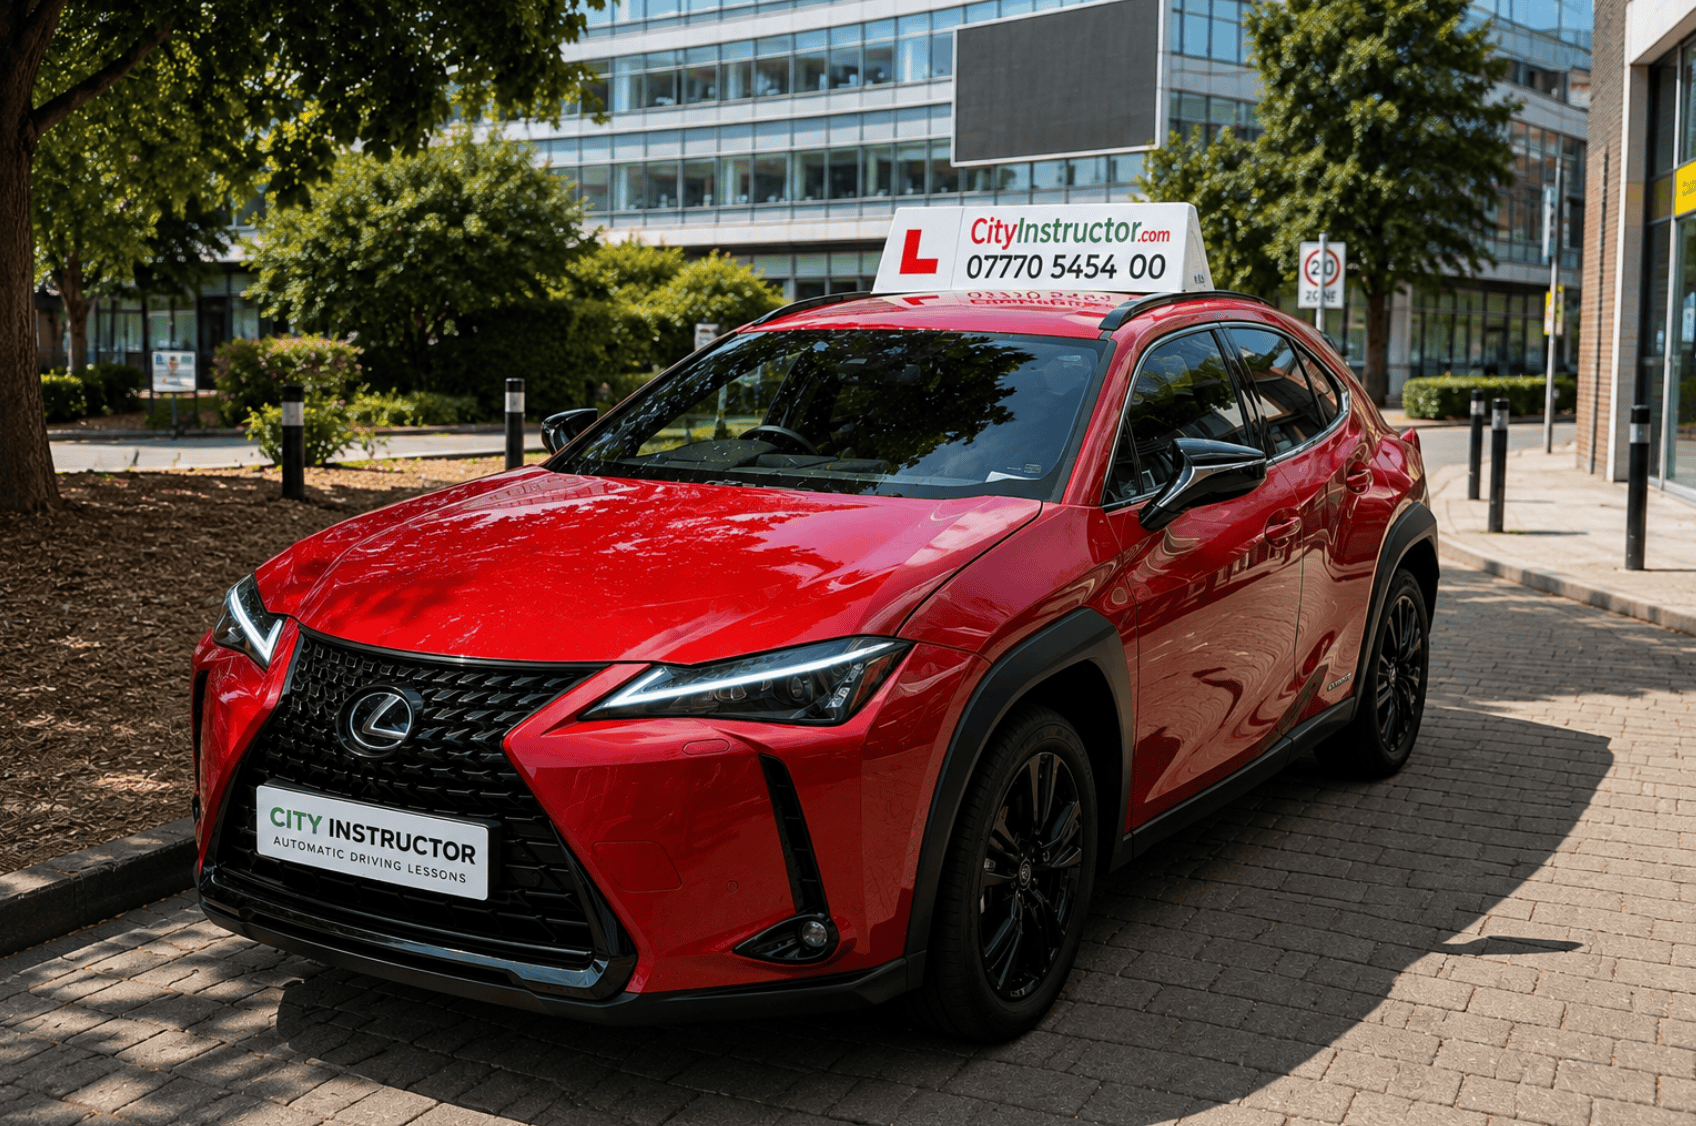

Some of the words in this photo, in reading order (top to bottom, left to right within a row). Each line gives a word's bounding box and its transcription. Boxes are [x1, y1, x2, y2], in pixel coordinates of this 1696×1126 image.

[899, 229, 939, 275] L
[971, 216, 1171, 250] CityInstructor.com
[966, 254, 1044, 280] 07770
[1050, 253, 1117, 280] 5454
[1128, 253, 1166, 280] 00
[1310, 260, 1335, 276] 20
[270, 807, 323, 834] CITY
[329, 818, 476, 865] INSTRUCTOR
[273, 836, 345, 860] AUTOMATIC
[350, 851, 402, 871] DRIVING
[407, 863, 466, 883] LESSONS
